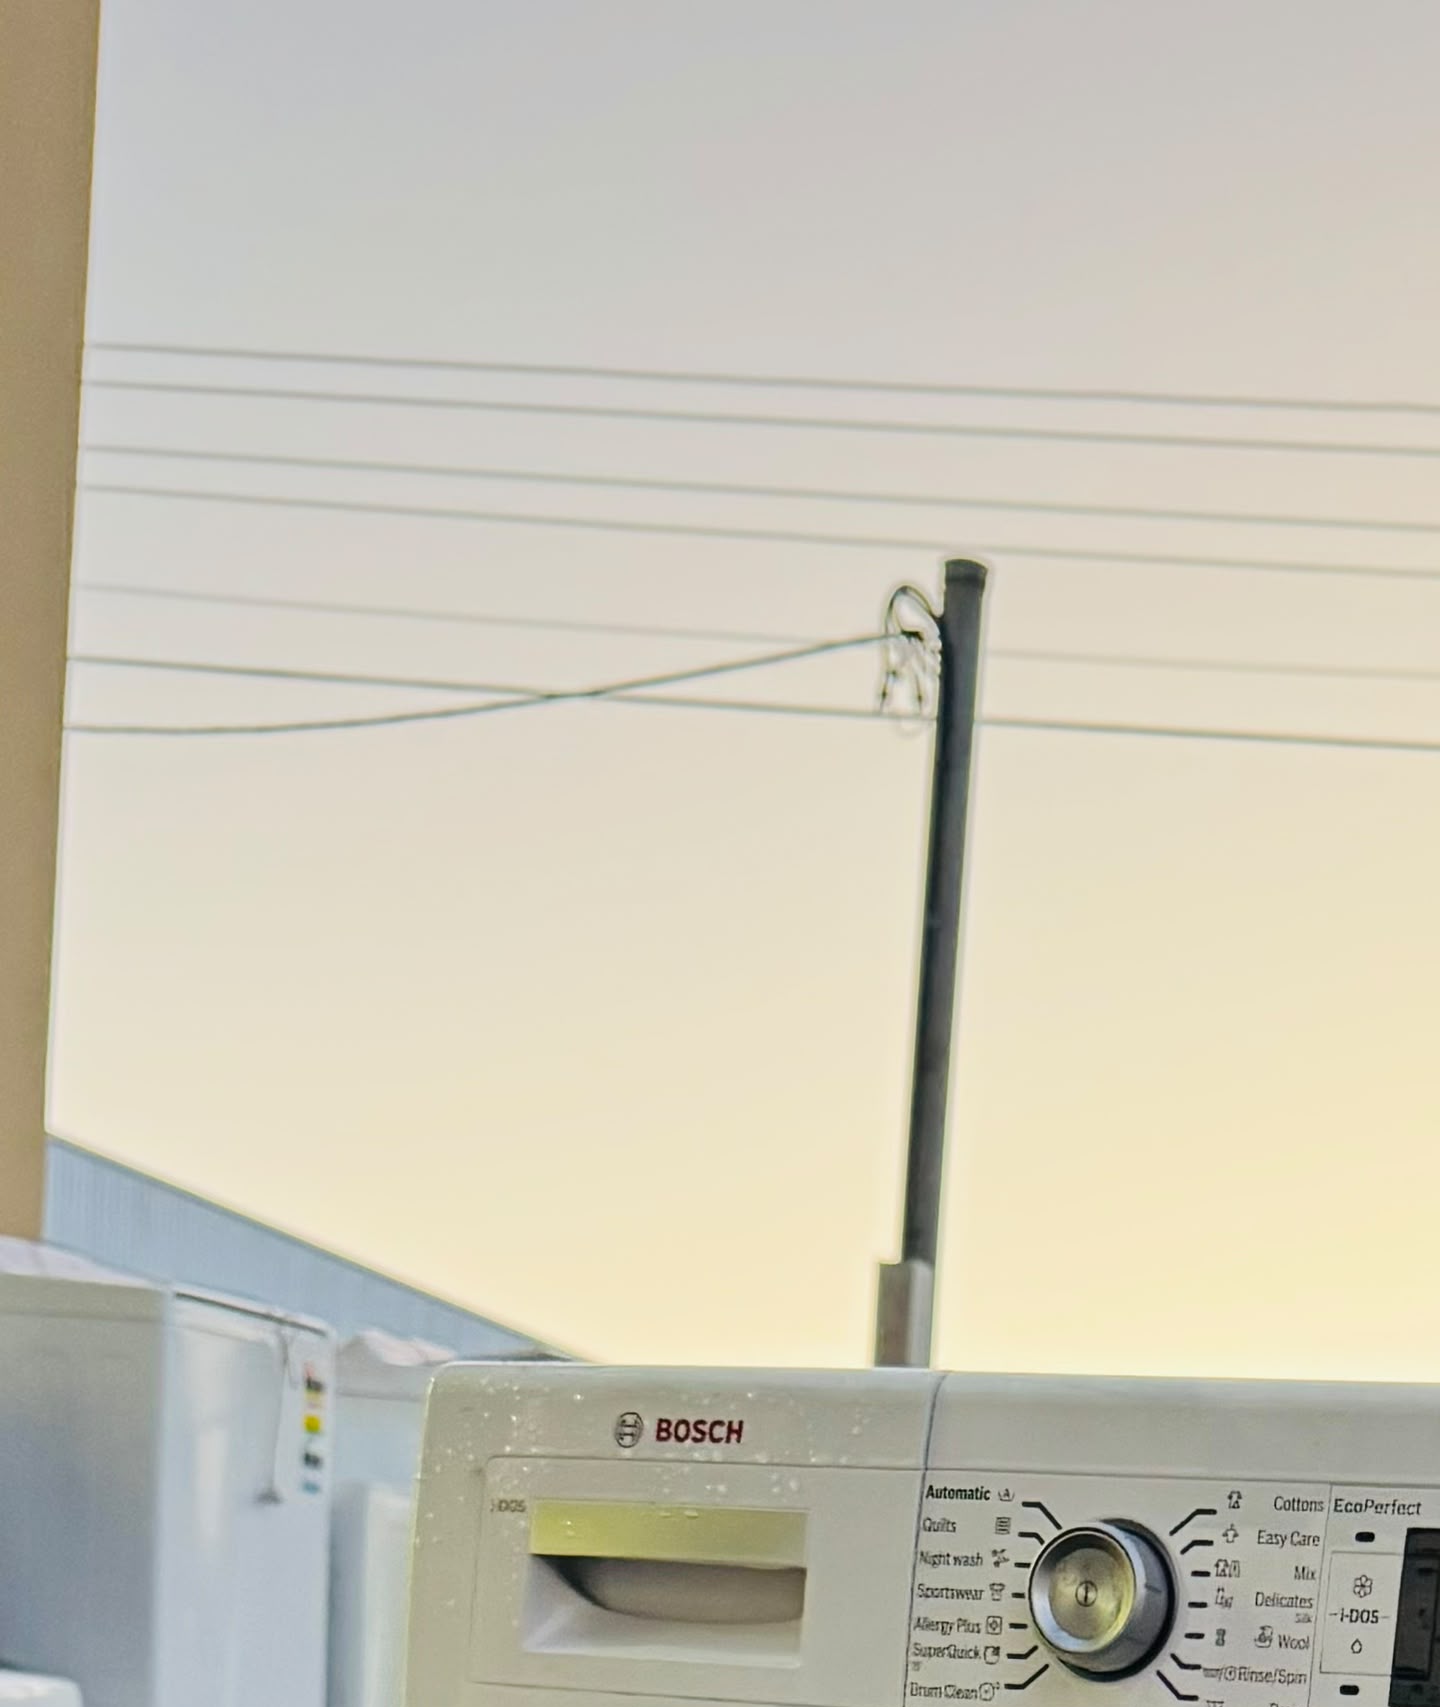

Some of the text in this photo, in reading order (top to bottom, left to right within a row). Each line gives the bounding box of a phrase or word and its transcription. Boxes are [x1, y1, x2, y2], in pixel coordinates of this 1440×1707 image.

[656, 1418, 744, 1444] BOSCH
[925, 1485, 991, 1501] Automatic
[1273, 1495, 1325, 1512] Cottons
[1333, 1498, 1422, 1516] EcoPerfect
[1257, 1529, 1320, 1548] Easy Care
[953, 1552, 983, 1567] wash
[1294, 1565, 1316, 1581] Mix
[1255, 1591, 1313, 1609] Delicates
[957, 1618, 981, 1634] Plus
[1278, 1634, 1310, 1650] Wool
